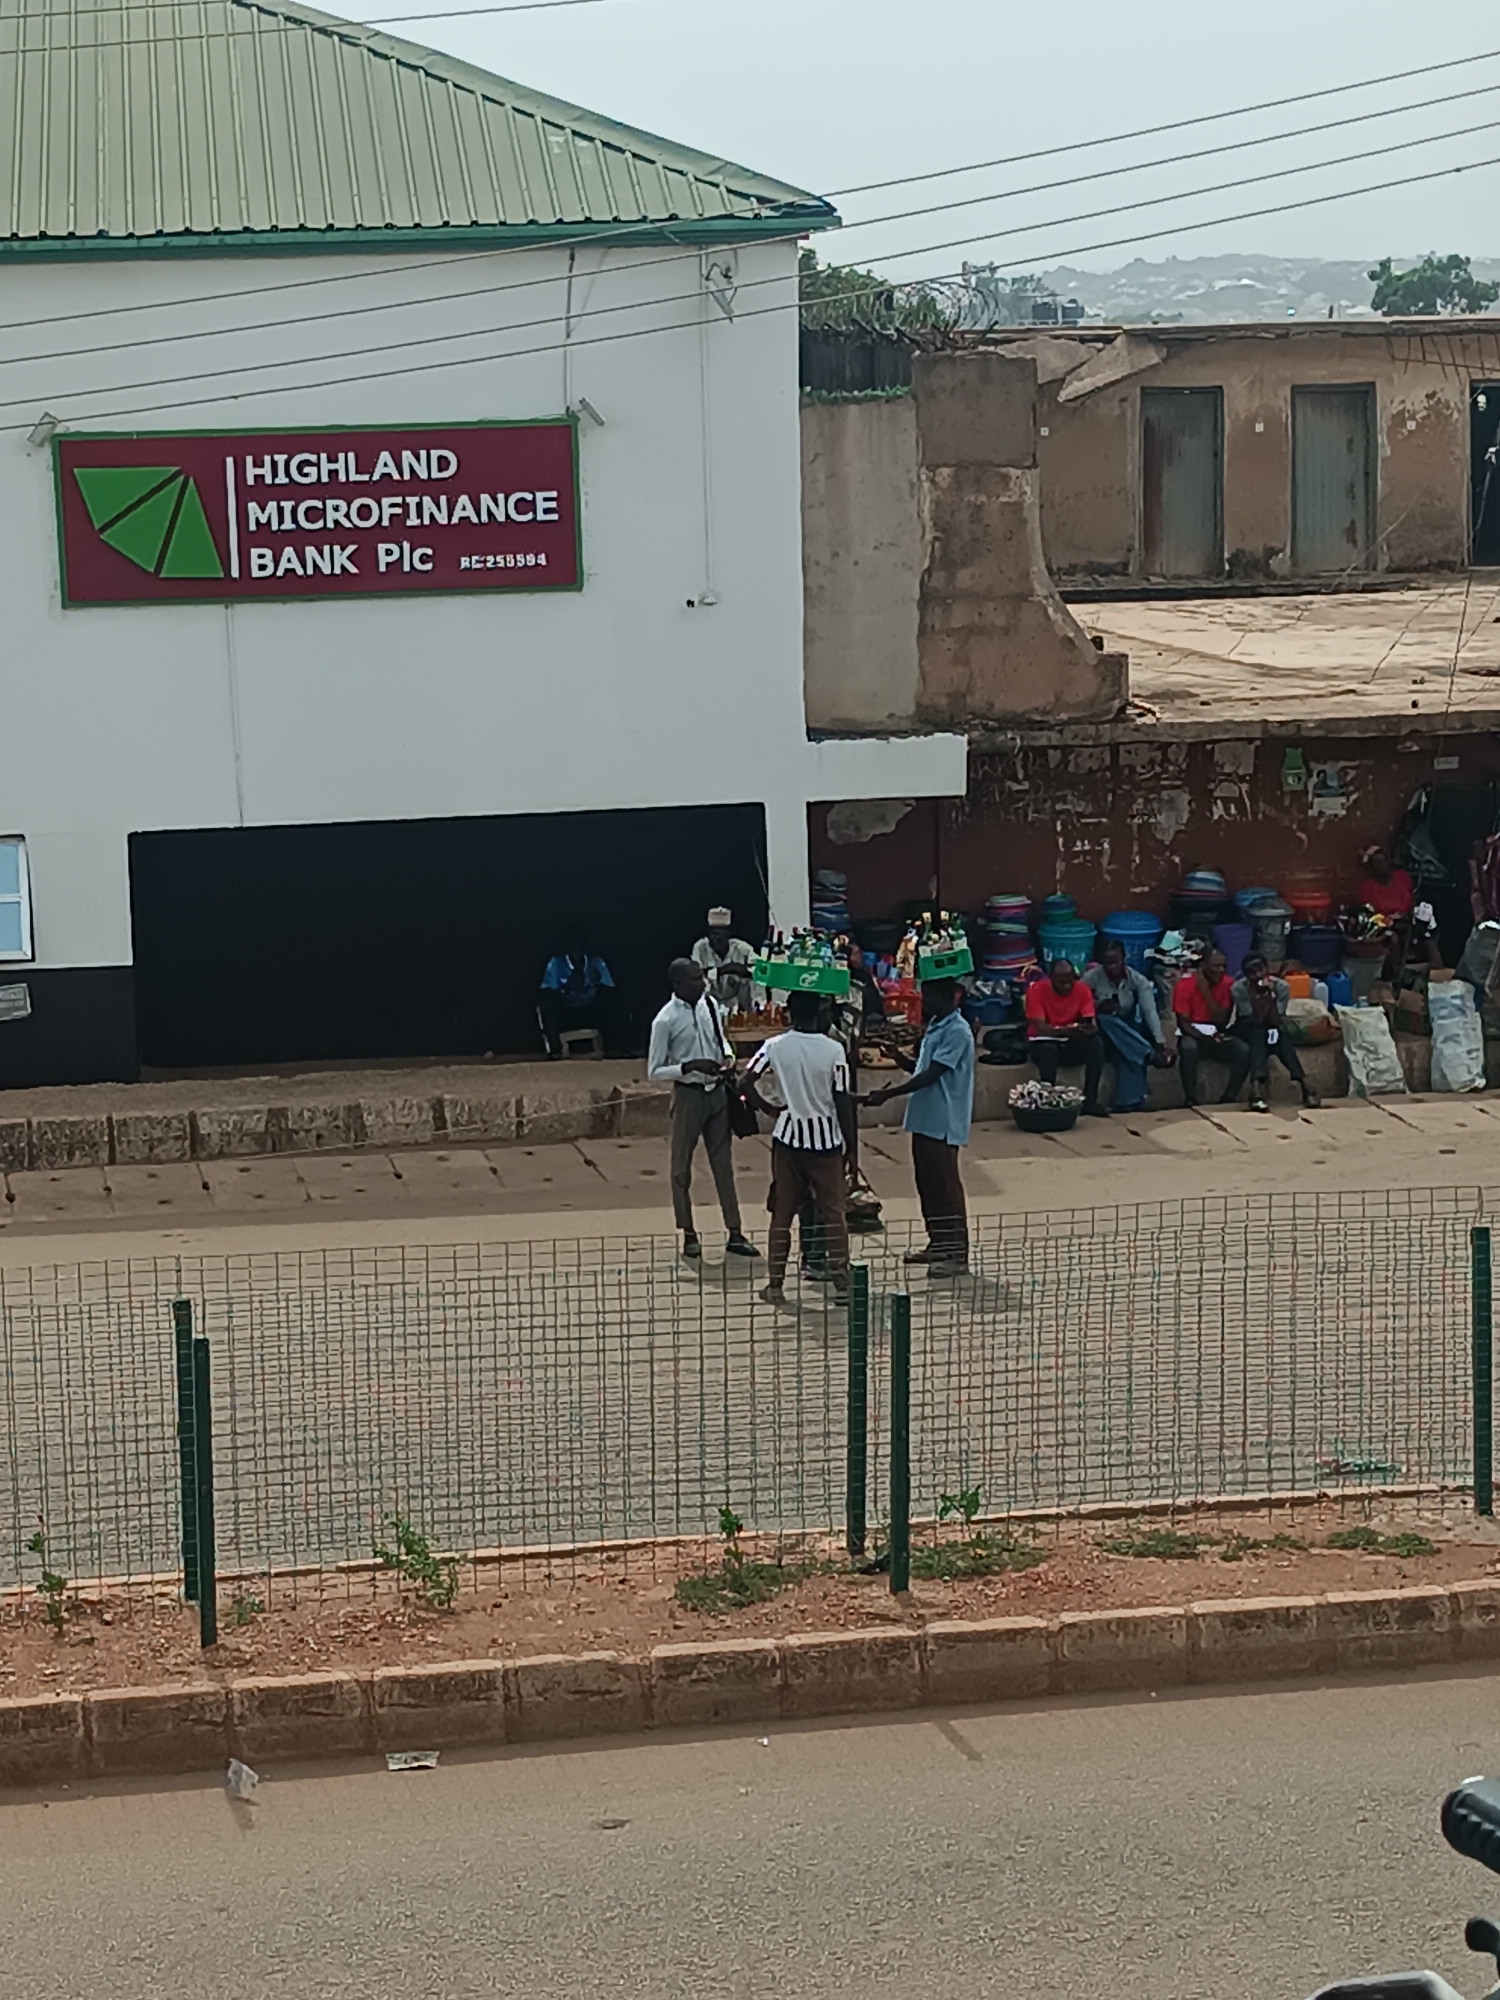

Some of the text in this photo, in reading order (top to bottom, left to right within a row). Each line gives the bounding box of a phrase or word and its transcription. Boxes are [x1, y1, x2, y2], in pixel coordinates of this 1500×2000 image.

[245, 449, 458, 486] HIGHLAND
[247, 490, 560, 531] MICROFINANCE
[250, 544, 359, 578] BANK
[377, 541, 433, 572] Plc
